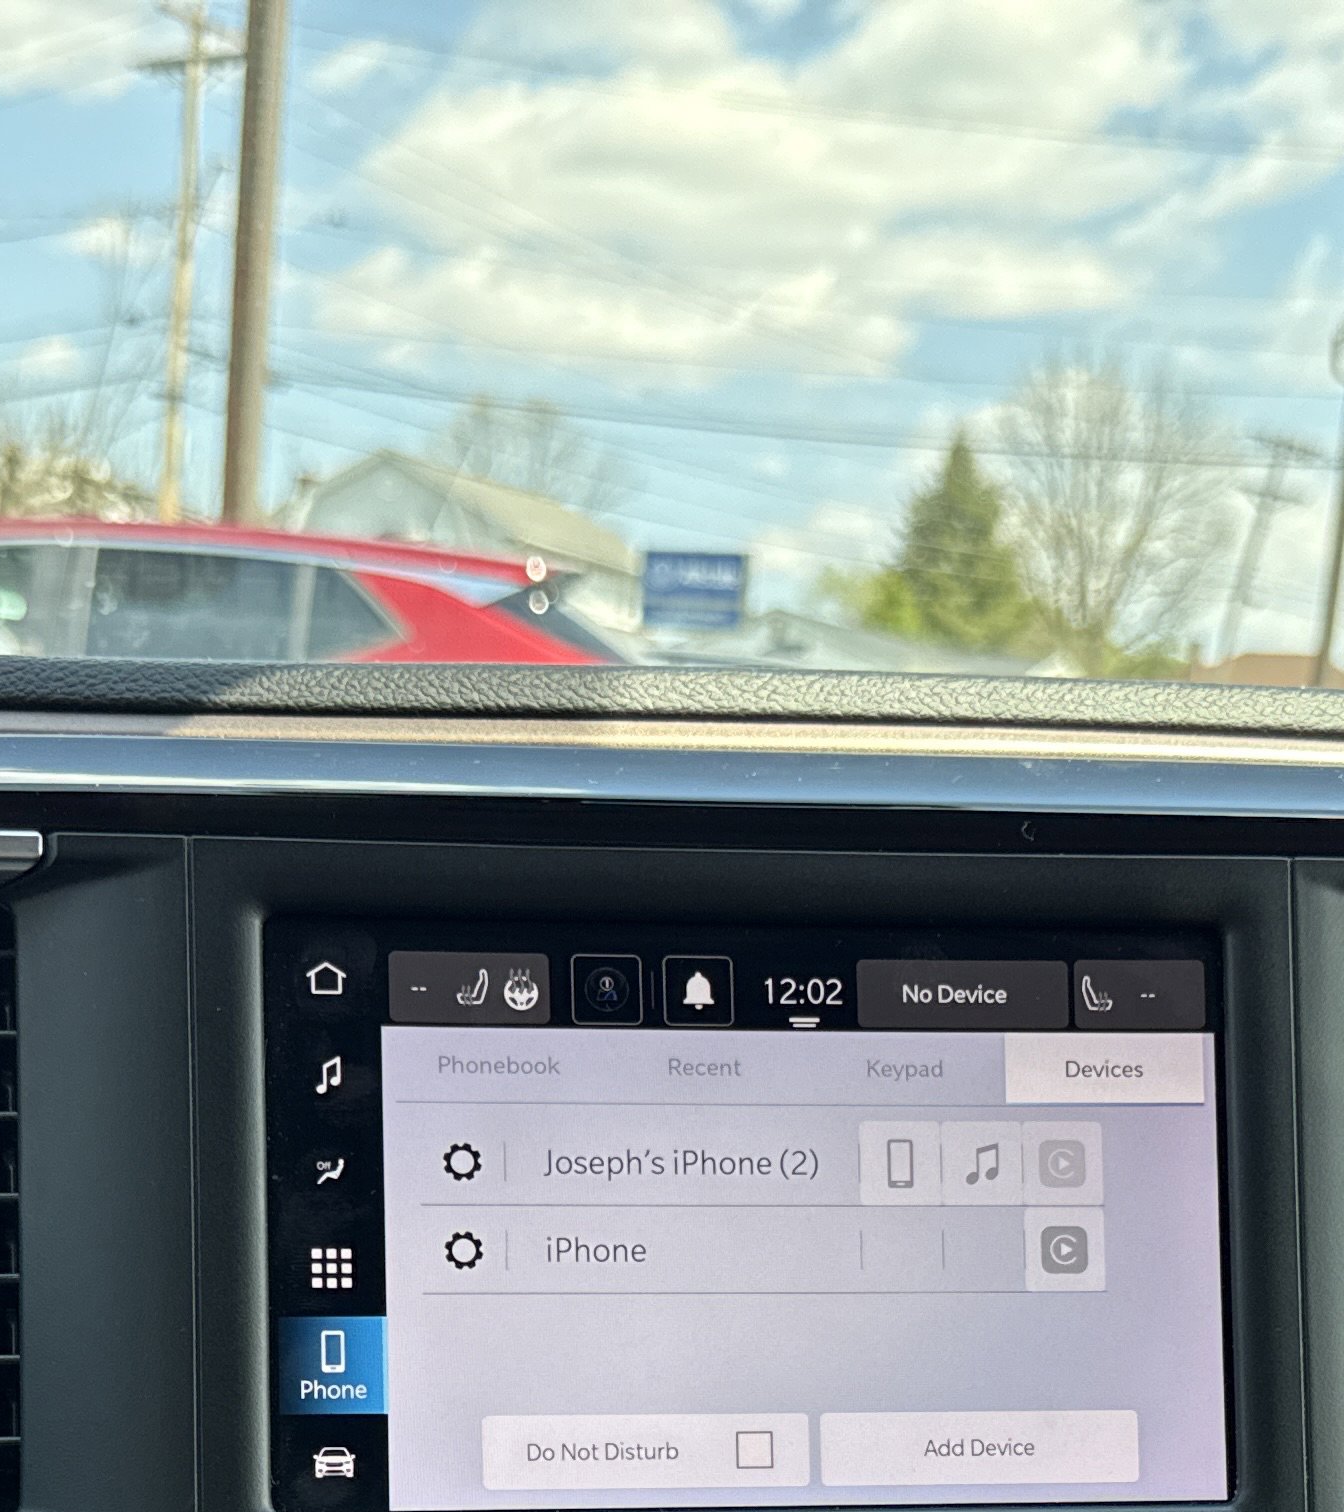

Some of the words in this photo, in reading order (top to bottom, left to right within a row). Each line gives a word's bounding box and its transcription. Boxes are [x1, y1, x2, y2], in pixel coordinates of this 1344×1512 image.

[765, 978, 842, 1004] 12:02
[903, 985, 932, 1003] No
[938, 984, 1007, 1003] Device
[439, 1056, 560, 1074] Phonebook
[669, 1058, 740, 1076] Recent
[867, 1059, 943, 1081] Keypad
[1066, 1060, 1143, 1078] Devices
[544, 1149, 664, 1181] Joseph's
[674, 1150, 771, 1175] iPhone
[780, 1149, 818, 1179] (2)
[547, 1237, 646, 1262] iPhone
[300, 1380, 368, 1400] Phone
[528, 1444, 555, 1461] Do
[562, 1443, 598, 1460] Not
[605, 1442, 678, 1460] Disturb
[924, 1439, 964, 1456] Add
[971, 1439, 1034, 1456] Device
